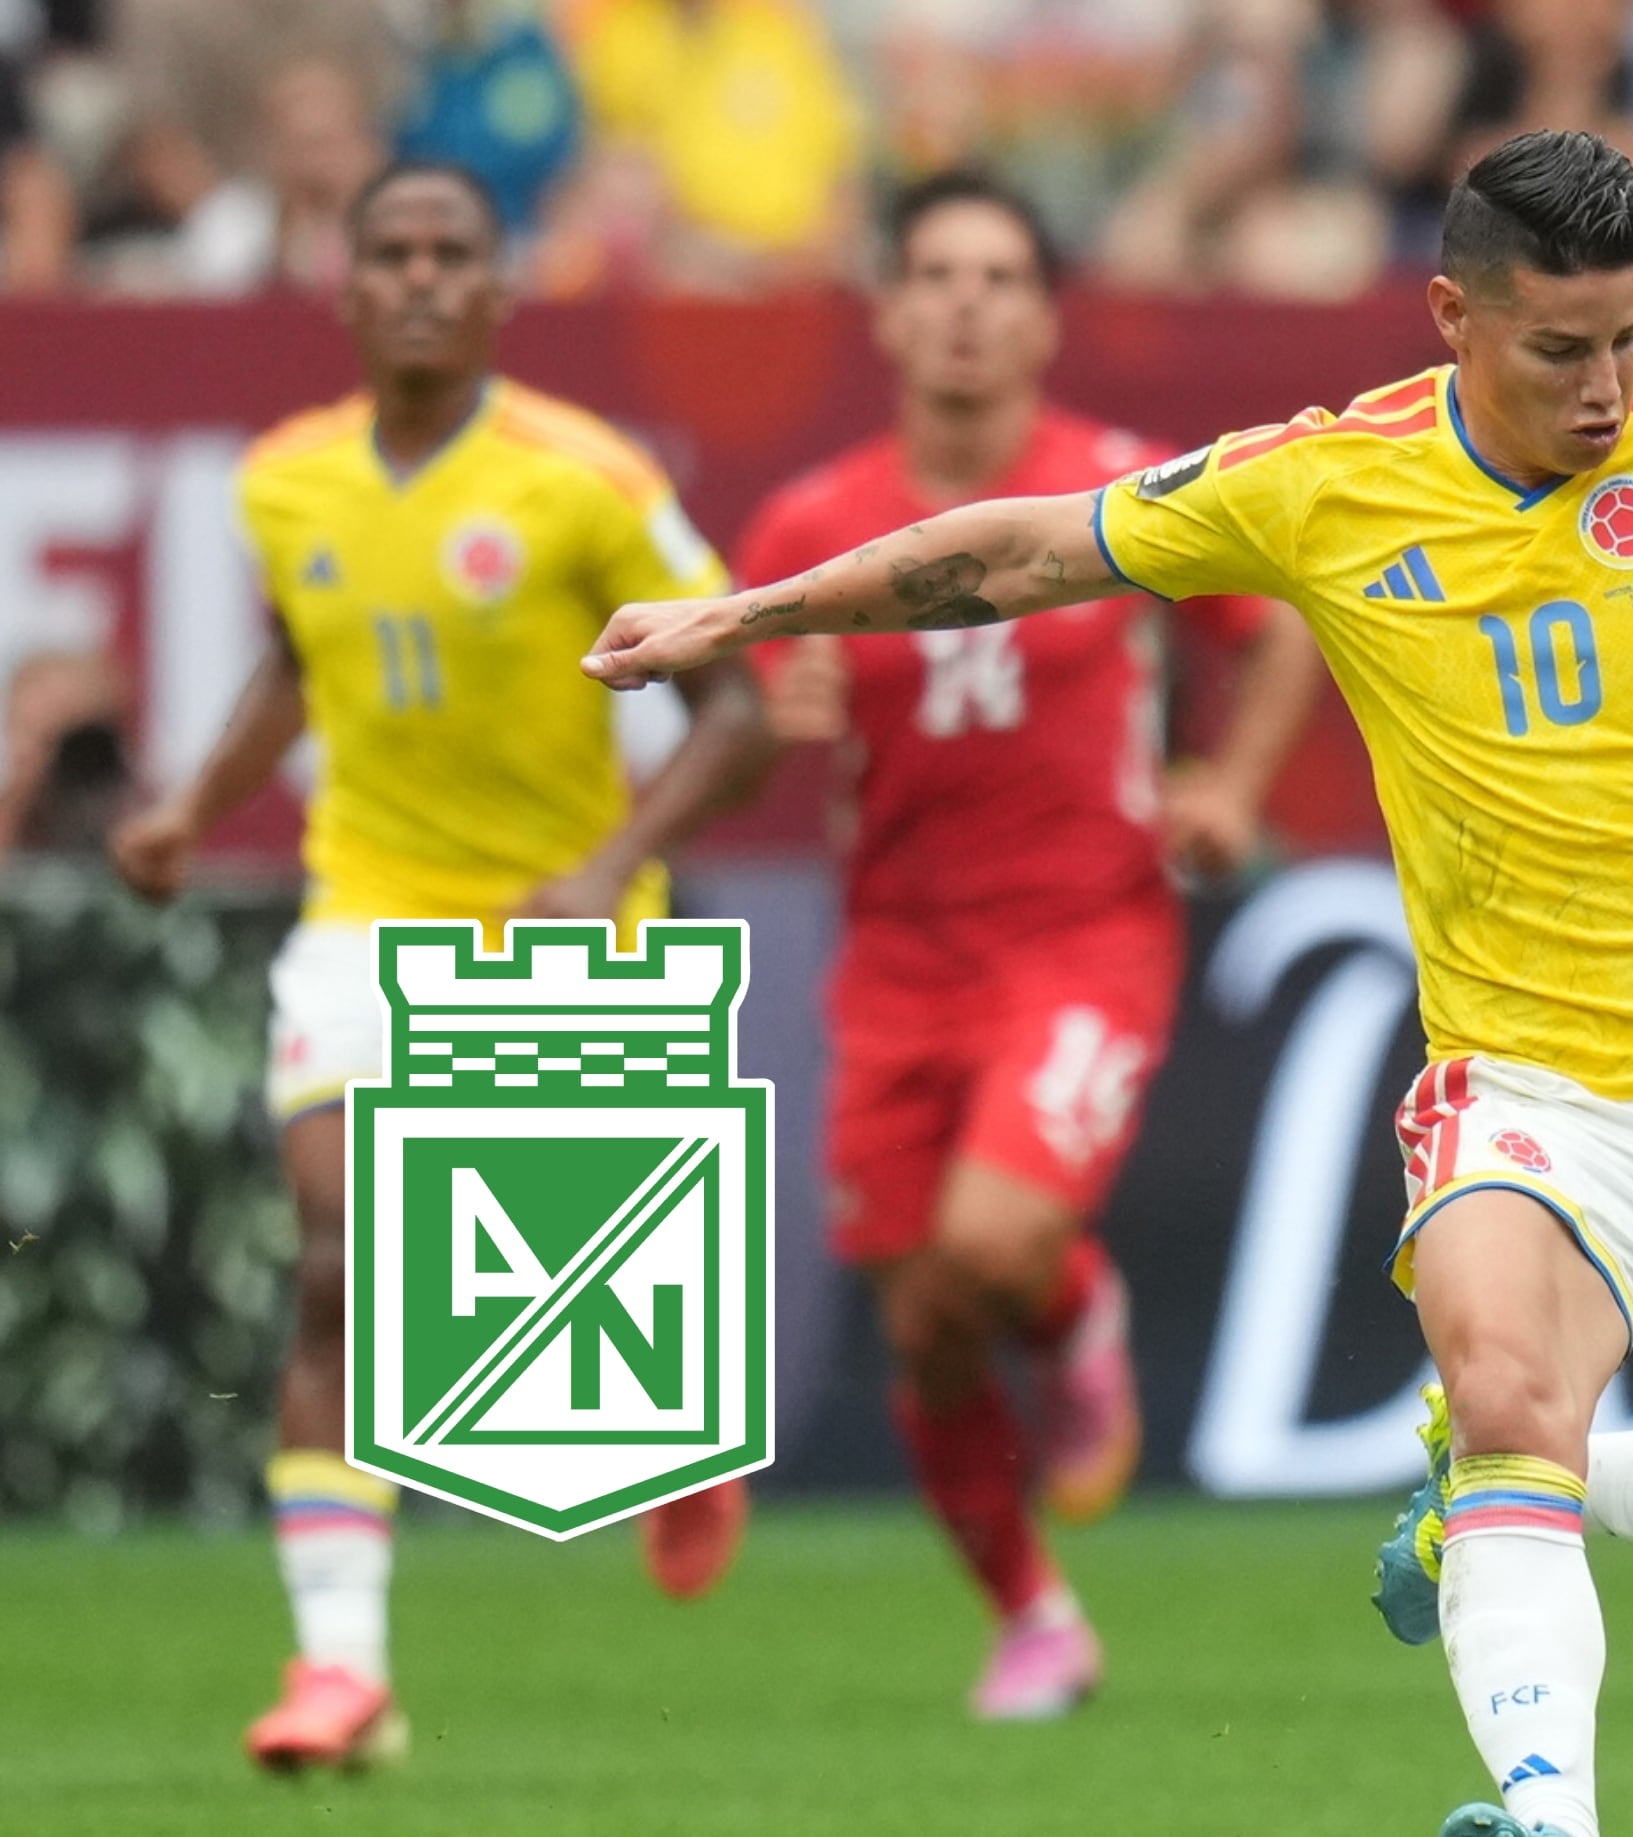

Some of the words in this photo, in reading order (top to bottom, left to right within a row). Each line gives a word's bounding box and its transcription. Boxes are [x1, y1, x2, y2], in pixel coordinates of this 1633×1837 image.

[373, 610, 443, 714] 11
[1478, 600, 1602, 736] 10
[1491, 1685, 1550, 1714] FCF
